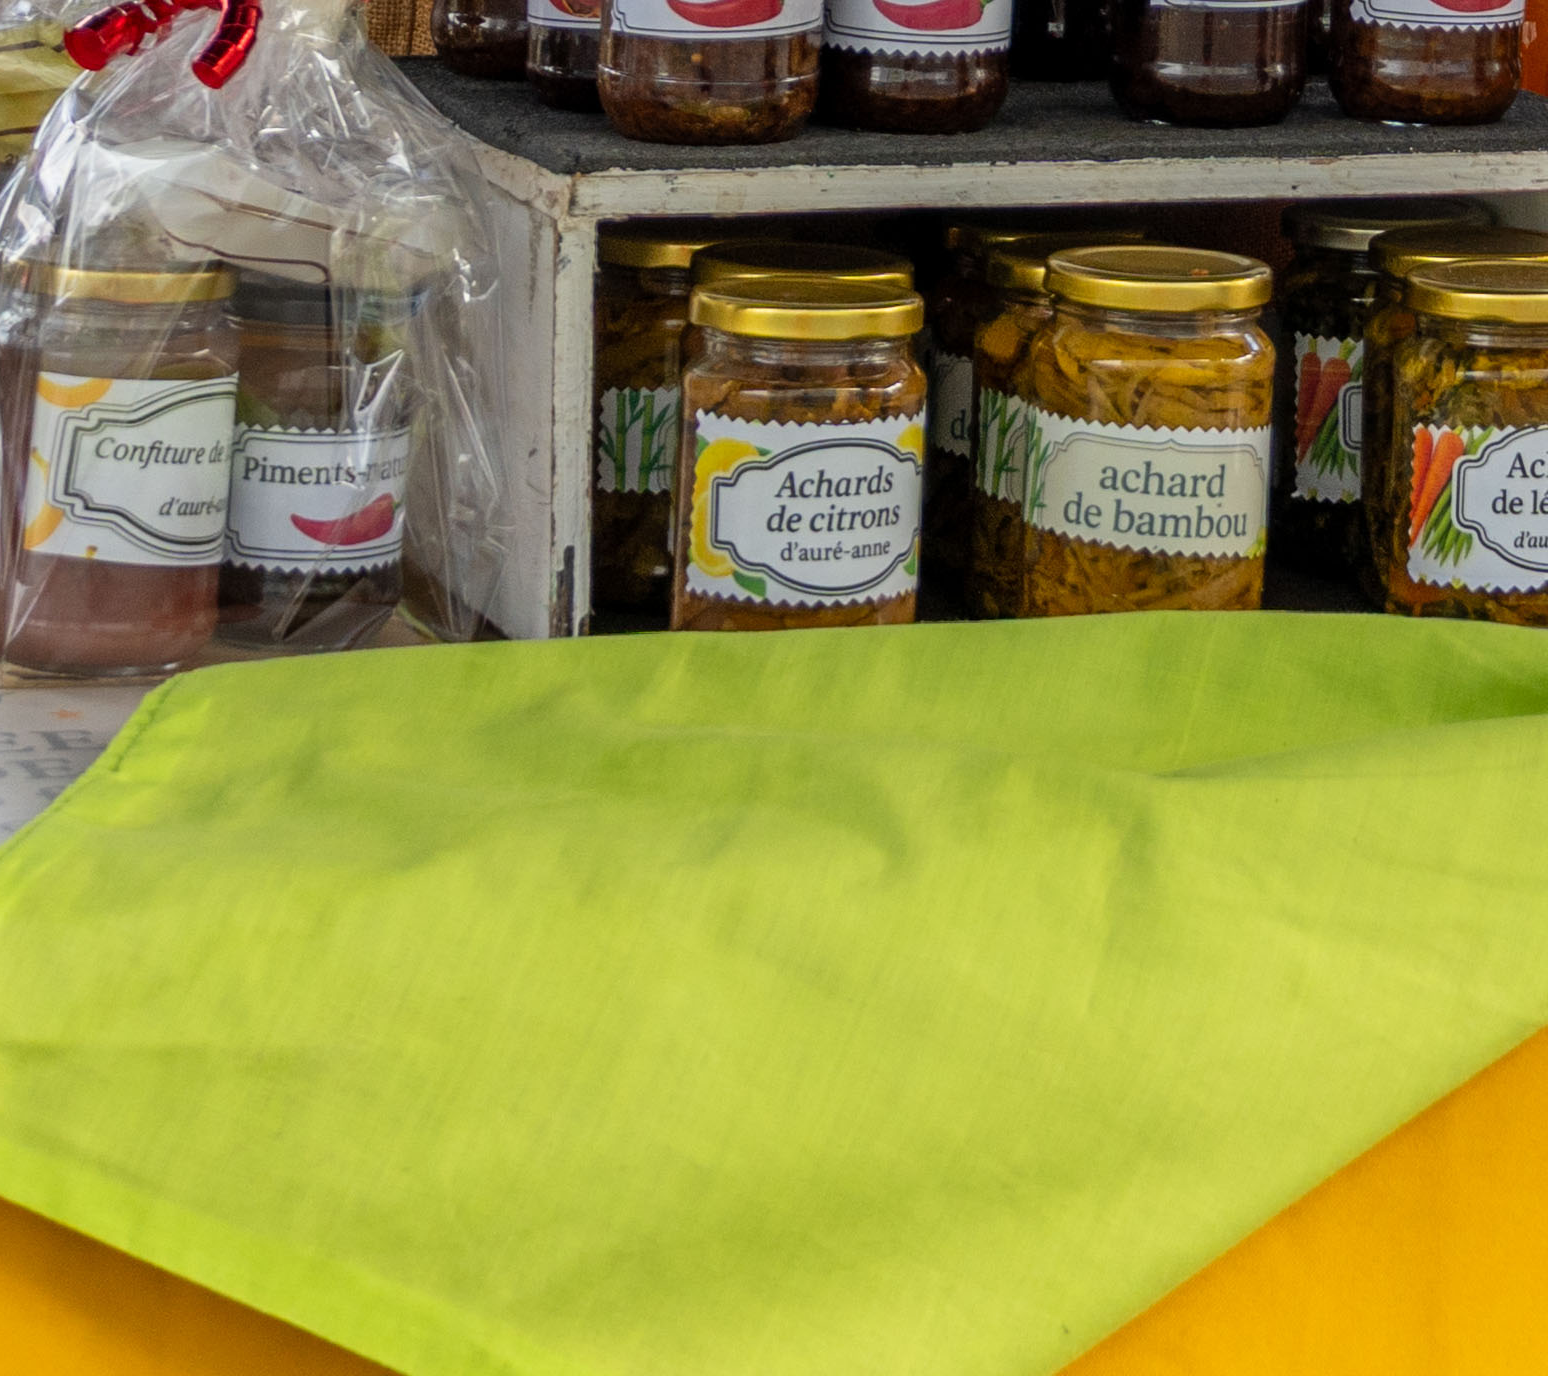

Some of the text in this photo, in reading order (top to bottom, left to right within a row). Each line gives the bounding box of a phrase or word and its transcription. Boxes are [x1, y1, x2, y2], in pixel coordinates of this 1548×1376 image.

[95, 436, 206, 469] Confiture
[774, 465, 894, 500] Achards
[1098, 459, 1226, 500] achard
[765, 498, 901, 533] de citrons
[1062, 491, 1248, 540] de bambou
[1491, 488, 1523, 516] de
[779, 538, 892, 564] d'auré-anne
